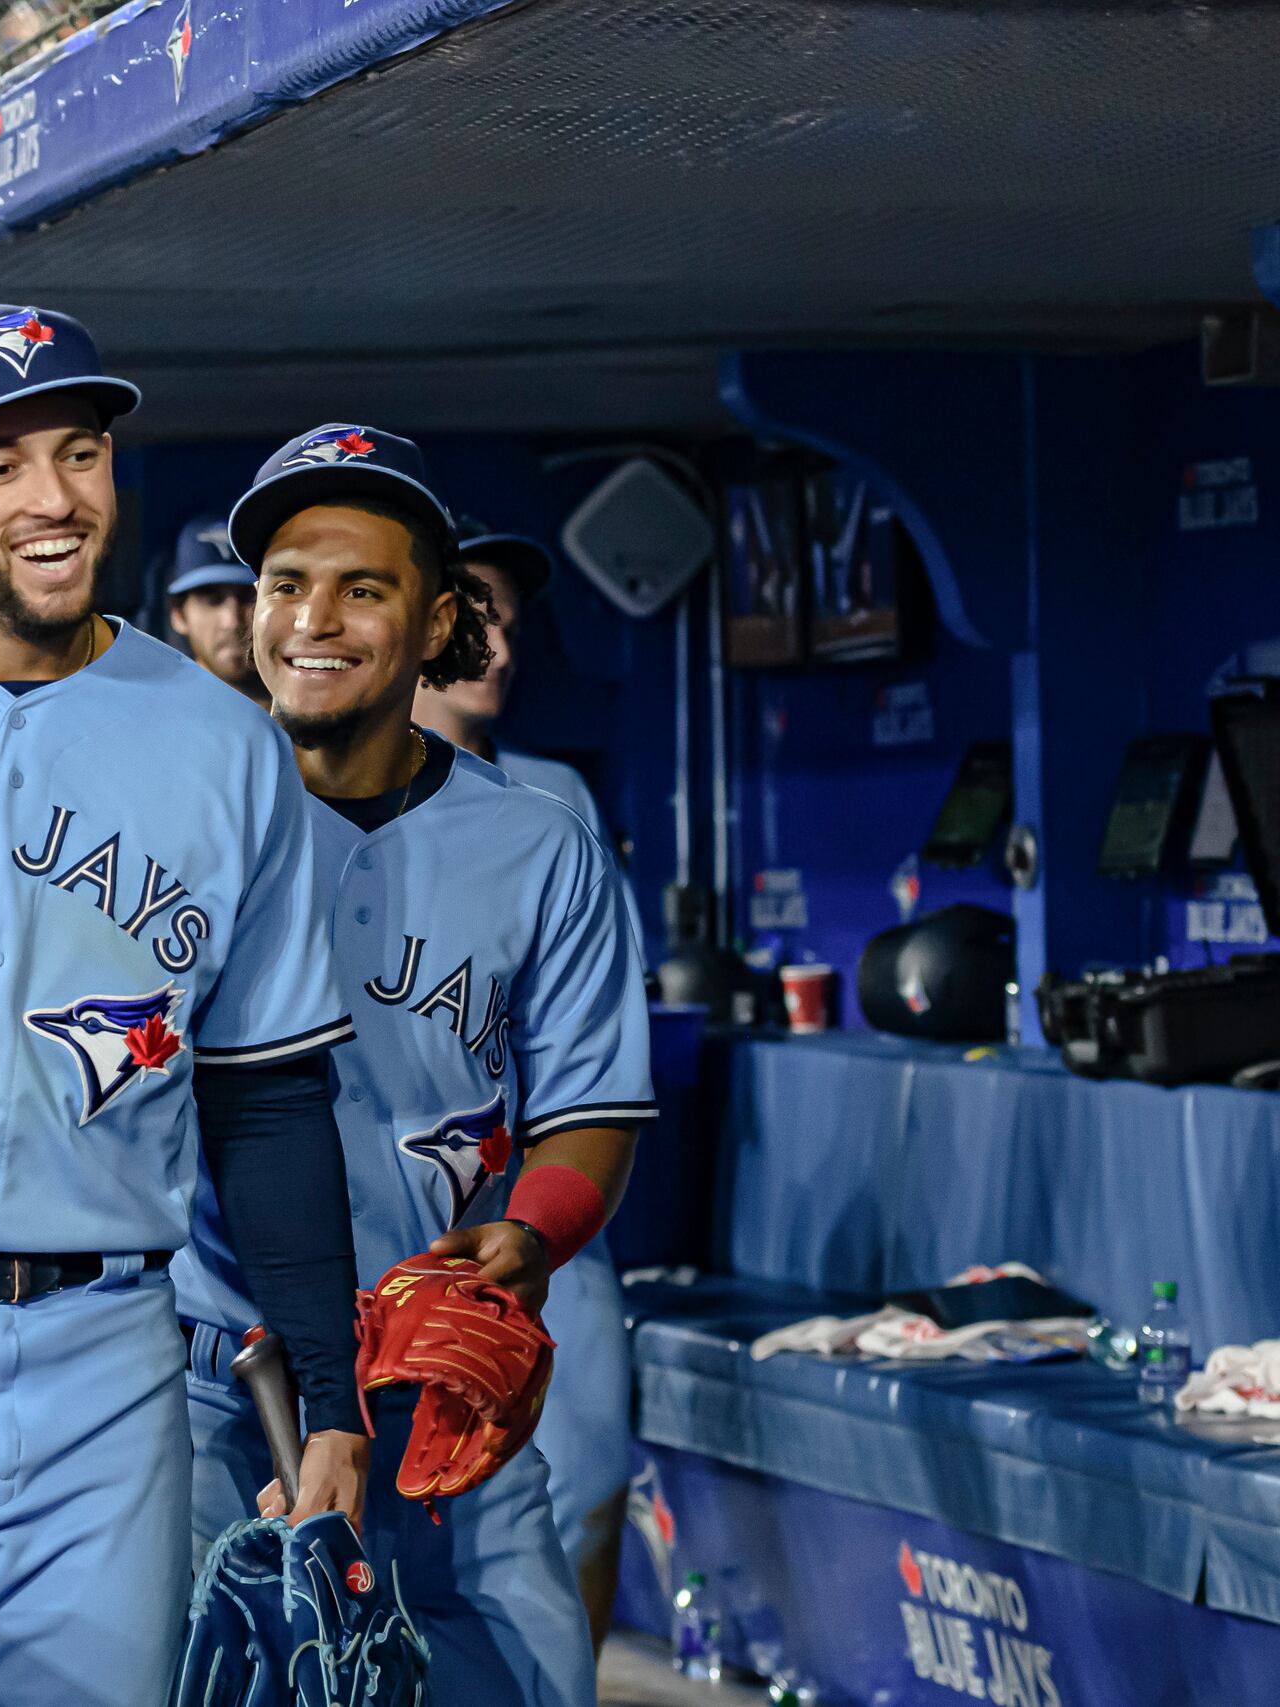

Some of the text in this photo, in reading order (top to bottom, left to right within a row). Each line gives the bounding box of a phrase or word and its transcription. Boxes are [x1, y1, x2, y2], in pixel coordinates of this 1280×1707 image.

[11, 805, 210, 974] JAYS
[363, 934, 511, 1081] JAYS
[900, 1600, 1063, 1707] BLUE JAYS
[917, 1550, 1028, 1633] TORONTO
